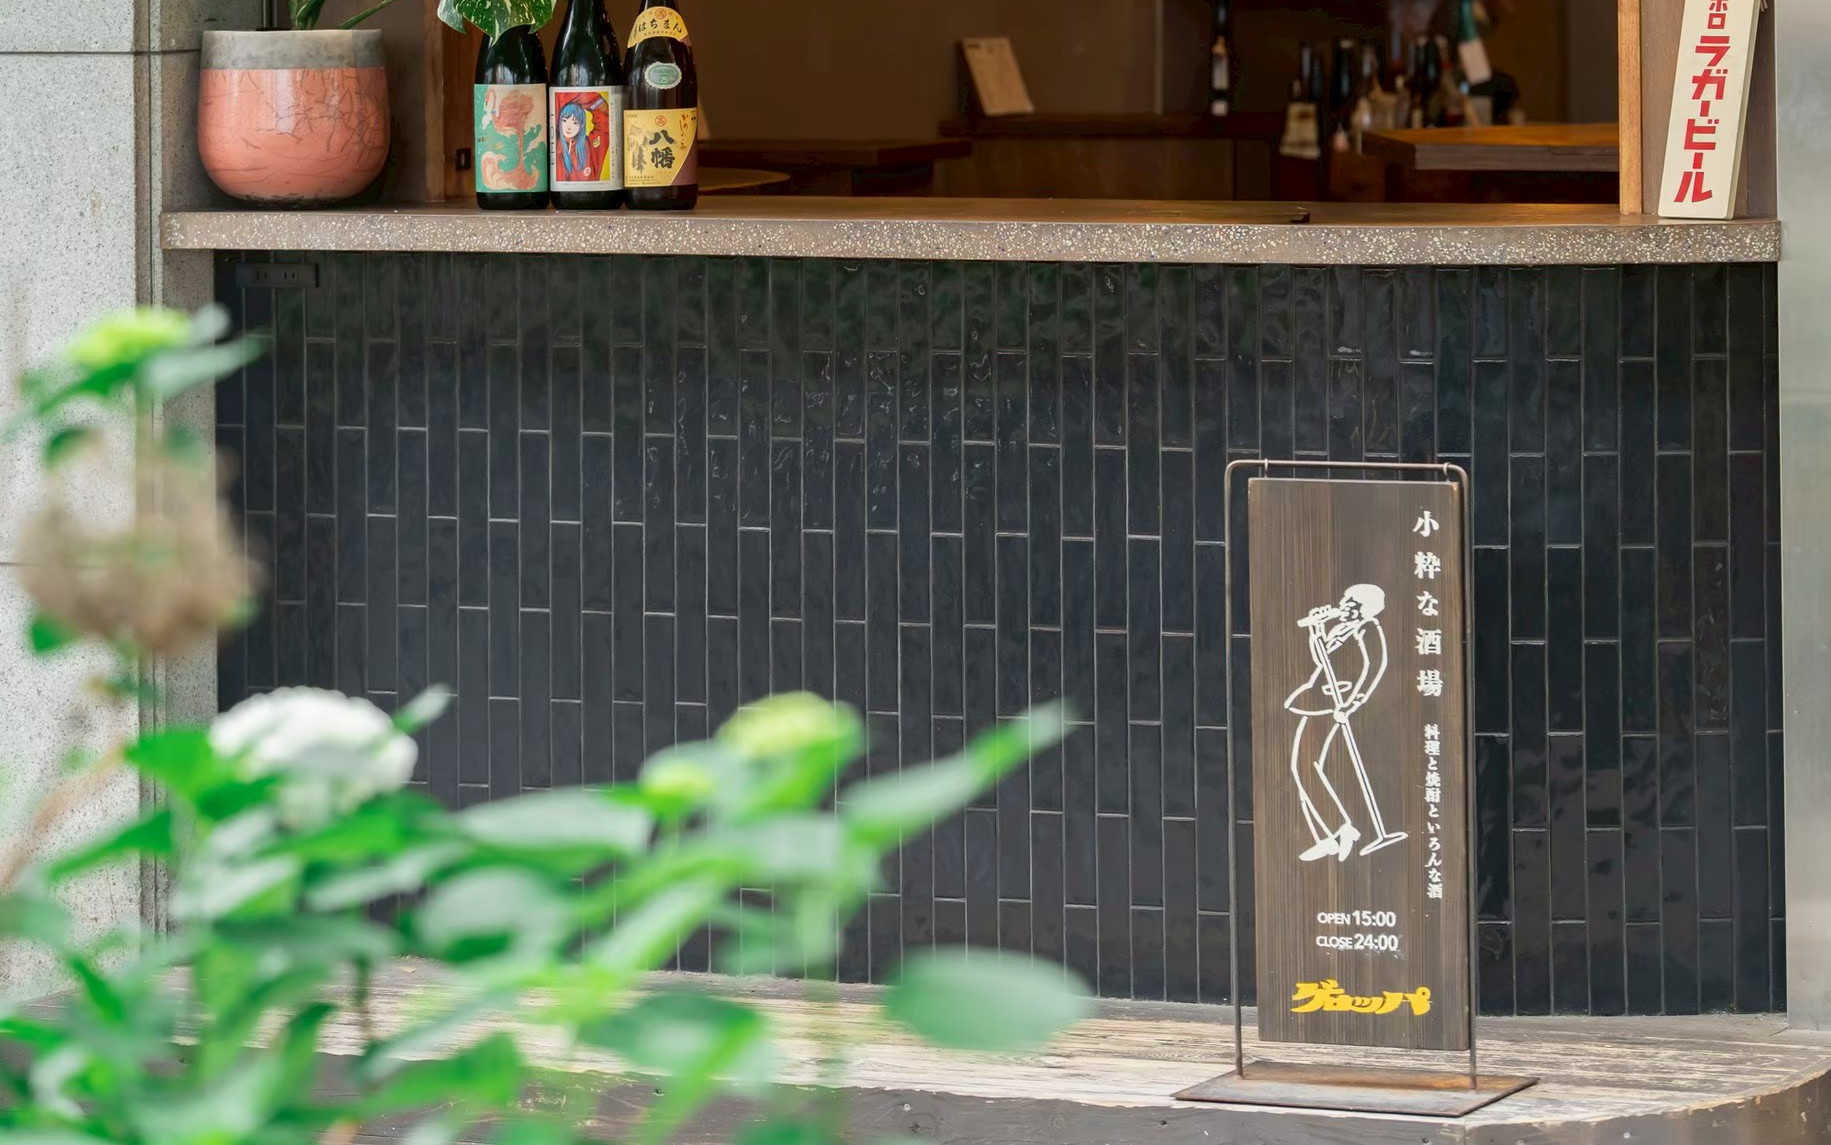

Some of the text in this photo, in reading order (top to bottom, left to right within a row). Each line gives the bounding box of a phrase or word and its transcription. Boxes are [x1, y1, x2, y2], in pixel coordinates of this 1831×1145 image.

[638, 18, 682, 33] はちまん
[649, 129, 675, 169] 八幡
[1412, 510, 1445, 697] 小粋な酒場
[1424, 723, 1443, 899] 料理と焼酎といろんな酒
[1317, 910, 1397, 927] OPEN 15:00
[1316, 933, 1399, 951] CLOSE 24:00
[1290, 978, 1431, 1016] ゲロッパ
